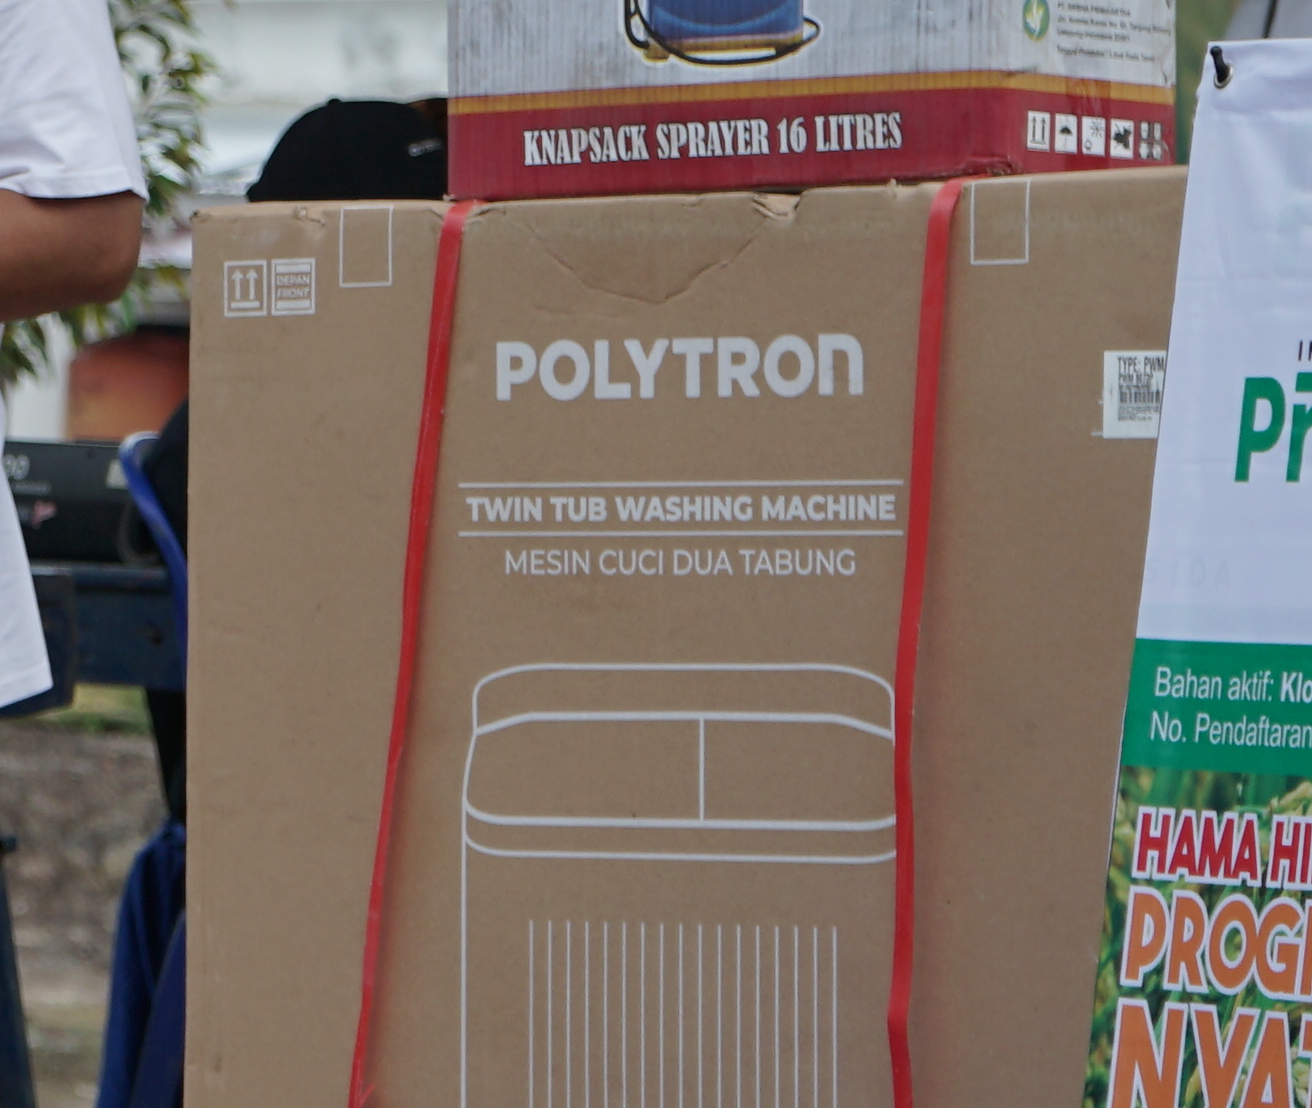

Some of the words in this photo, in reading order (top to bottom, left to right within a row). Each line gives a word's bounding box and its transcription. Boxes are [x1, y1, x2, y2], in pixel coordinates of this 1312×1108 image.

[523, 125, 651, 166] KNAPSACK
[656, 118, 770, 160] SPRAYER
[776, 117, 807, 154] 16
[814, 112, 903, 152] LITRES
[495, 333, 865, 402] POLYTRON
[466, 495, 543, 523] TWIN
[549, 496, 607, 523] TUB
[616, 494, 754, 522] WASHING
[761, 494, 897, 521] MACHINE
[504, 549, 590, 576] MESIN
[598, 548, 665, 575] CUCI
[673, 549, 734, 576] DUA
[739, 548, 857, 576] TABUNG
[1154, 666, 1223, 700] Bahan
[1227, 669, 1275, 702] aktif:
[1280, 671, 1312, 703] Klo
[1150, 710, 1187, 744] No.
[1194, 712, 1312, 749] Pendaftaran
[1131, 806, 1262, 888] HAMA
[1120, 884, 1312, 1002] PROG
